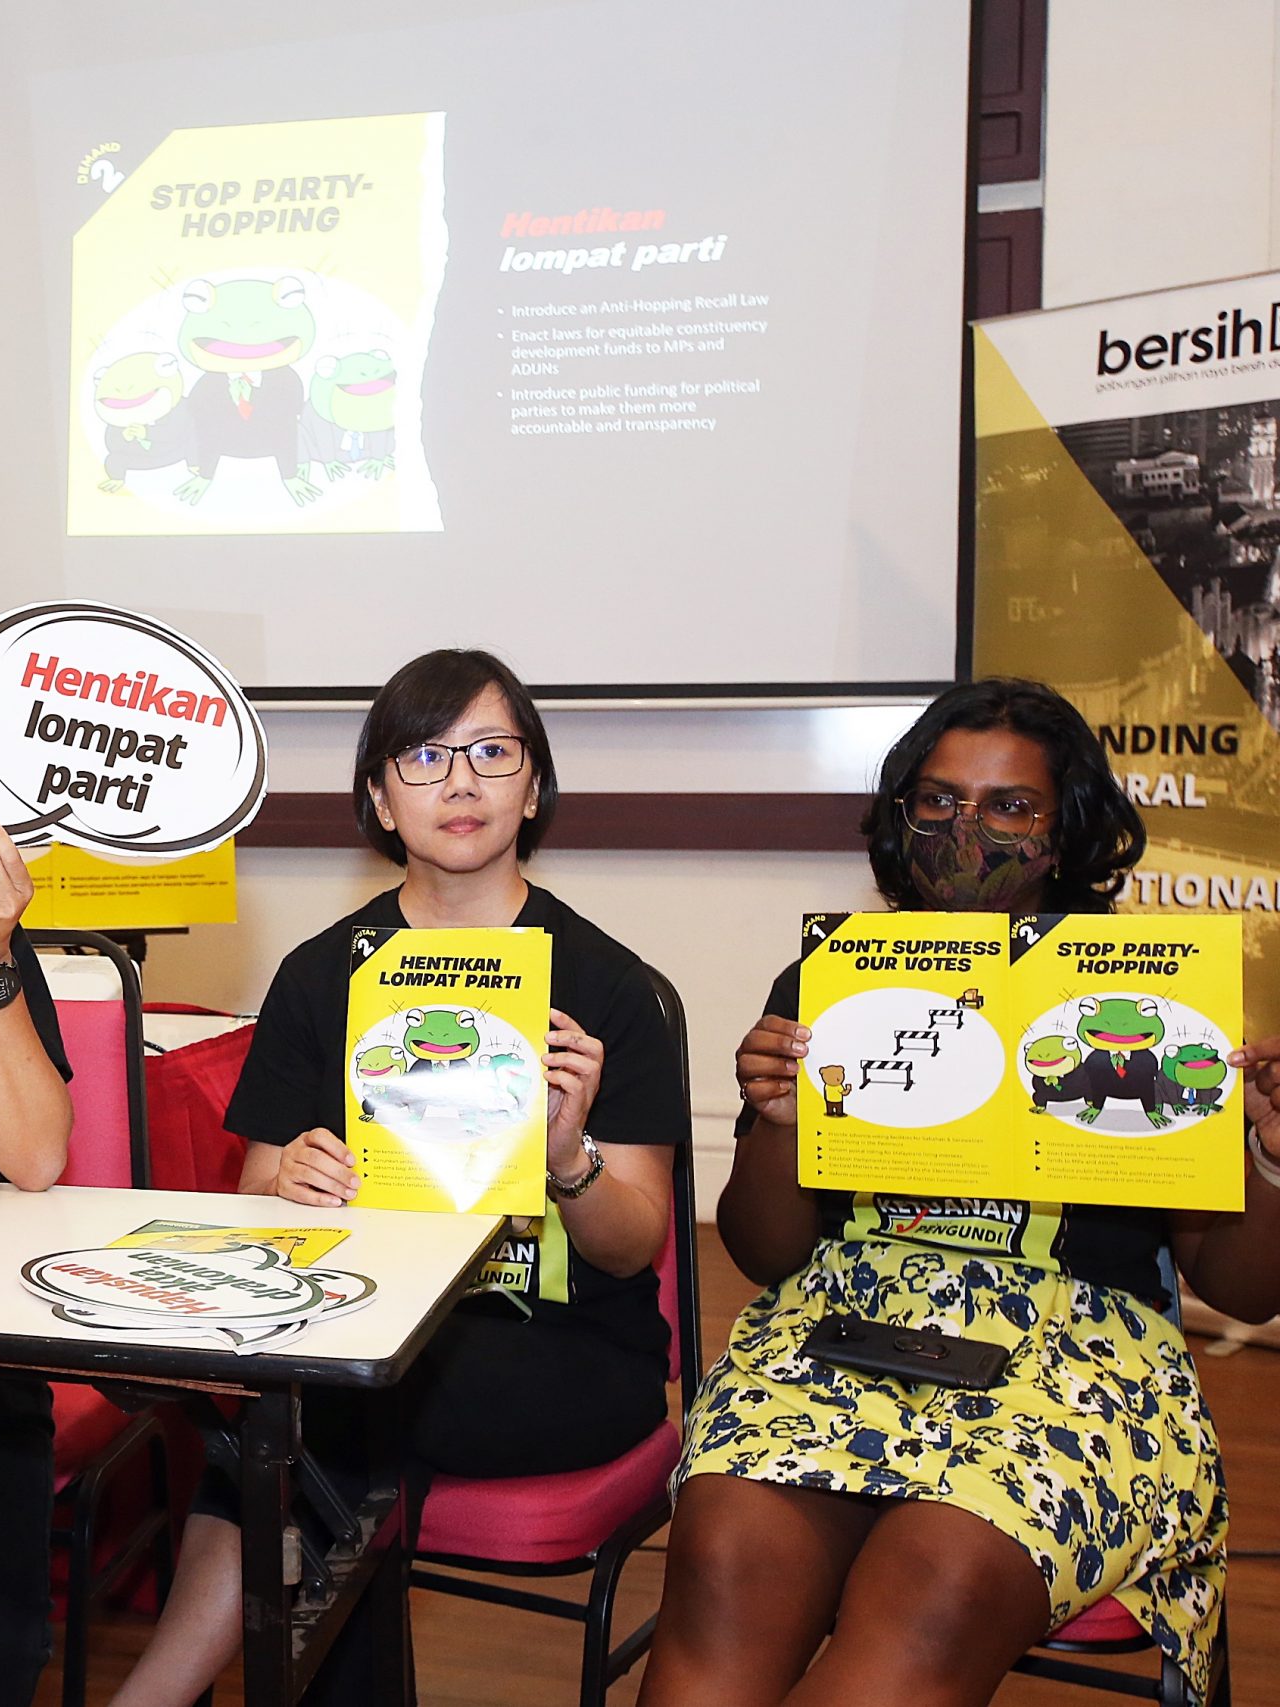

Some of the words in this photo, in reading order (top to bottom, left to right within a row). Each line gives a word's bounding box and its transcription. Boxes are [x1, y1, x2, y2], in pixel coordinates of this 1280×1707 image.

[77, 141, 121, 186] DEMAND
[90, 159, 126, 193] 2
[150, 181, 241, 210] STOP
[253, 173, 374, 204] PARTY-
[181, 206, 341, 238] HOPPING
[500, 208, 666, 238] Hentikan
[499, 241, 627, 274] lompat
[631, 234, 728, 271] parti
[512, 304, 577, 318] Introduce
[580, 304, 597, 315] an
[600, 298, 692, 315] Anti-Hopping
[695, 294, 737, 308] Recall
[740, 293, 770, 306] Law
[512, 329, 550, 342] Enact
[552, 327, 582, 340] laws
[586, 326, 605, 339] for
[608, 322, 673, 340] equitable
[676, 319, 768, 336] constituency
[1097, 308, 1262, 376] bersih
[512, 342, 600, 360] development
[603, 341, 642, 355] funds
[646, 342, 660, 354] to
[664, 340, 695, 353] MPs
[698, 337, 725, 351] and
[511, 362, 560, 376] ADUNs
[511, 387, 577, 400] Introduce
[579, 385, 621, 401] public
[624, 383, 677, 399] funding
[681, 381, 701, 394] for
[704, 379, 761, 396] political
[511, 405, 557, 419] parties
[561, 404, 575, 417] to
[579, 402, 615, 416] make
[619, 401, 656, 414] them
[659, 402, 696, 413] more
[511, 420, 592, 435] accountable
[596, 419, 622, 432] and
[625, 416, 716, 432] transparency
[20, 652, 228, 727] Hentikan
[24, 700, 188, 769] lompat
[36, 763, 153, 813] parti
[802, 915, 826, 937] DEMAND
[811, 924, 826, 940] 1
[1011, 915, 1038, 939] DEMAND
[1019, 925, 1041, 946] 2
[352, 929, 376, 954] TUNTUTAN
[357, 938, 375, 957] 2
[829, 939, 887, 953] DON'T
[892, 940, 1002, 955] SUPPRESS
[1056, 942, 1116, 958] STOP
[1122, 943, 1200, 959] PARTY-
[400, 956, 501, 972] HENTIKAN
[855, 956, 897, 971] OUR
[905, 957, 972, 972] VOTES
[1077, 960, 1179, 976] HOPPING
[379, 971, 460, 988] LOMPAT
[464, 973, 521, 989] PARTI
[915, 1225, 1003, 1245] PENGUNDI
[127, 1251, 302, 1300] drakonian
[129, 1265, 217, 1294] akta
[51, 1263, 222, 1314] Hapuskan
